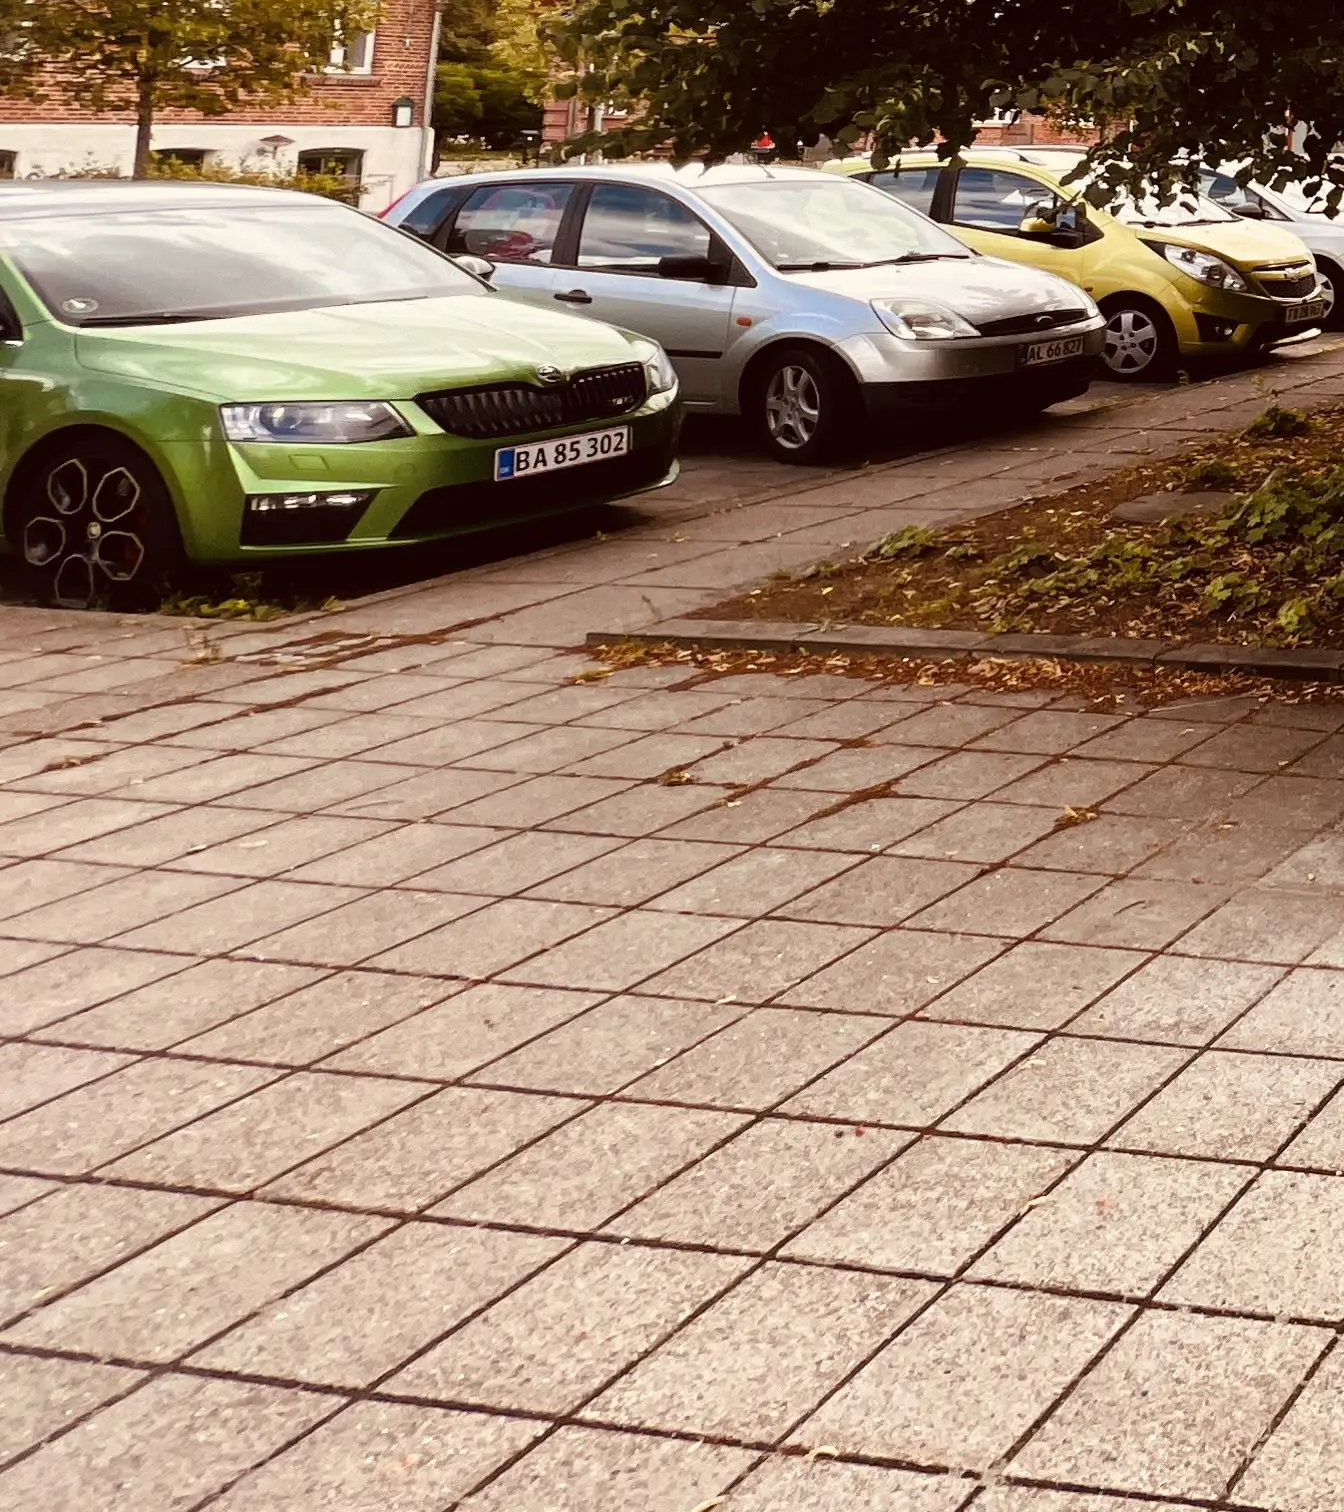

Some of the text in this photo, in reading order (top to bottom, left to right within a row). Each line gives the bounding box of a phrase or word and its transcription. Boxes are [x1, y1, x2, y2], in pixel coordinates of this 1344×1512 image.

[1047, 343, 1060, 358] 66
[516, 432, 624, 472] BA 85 302
